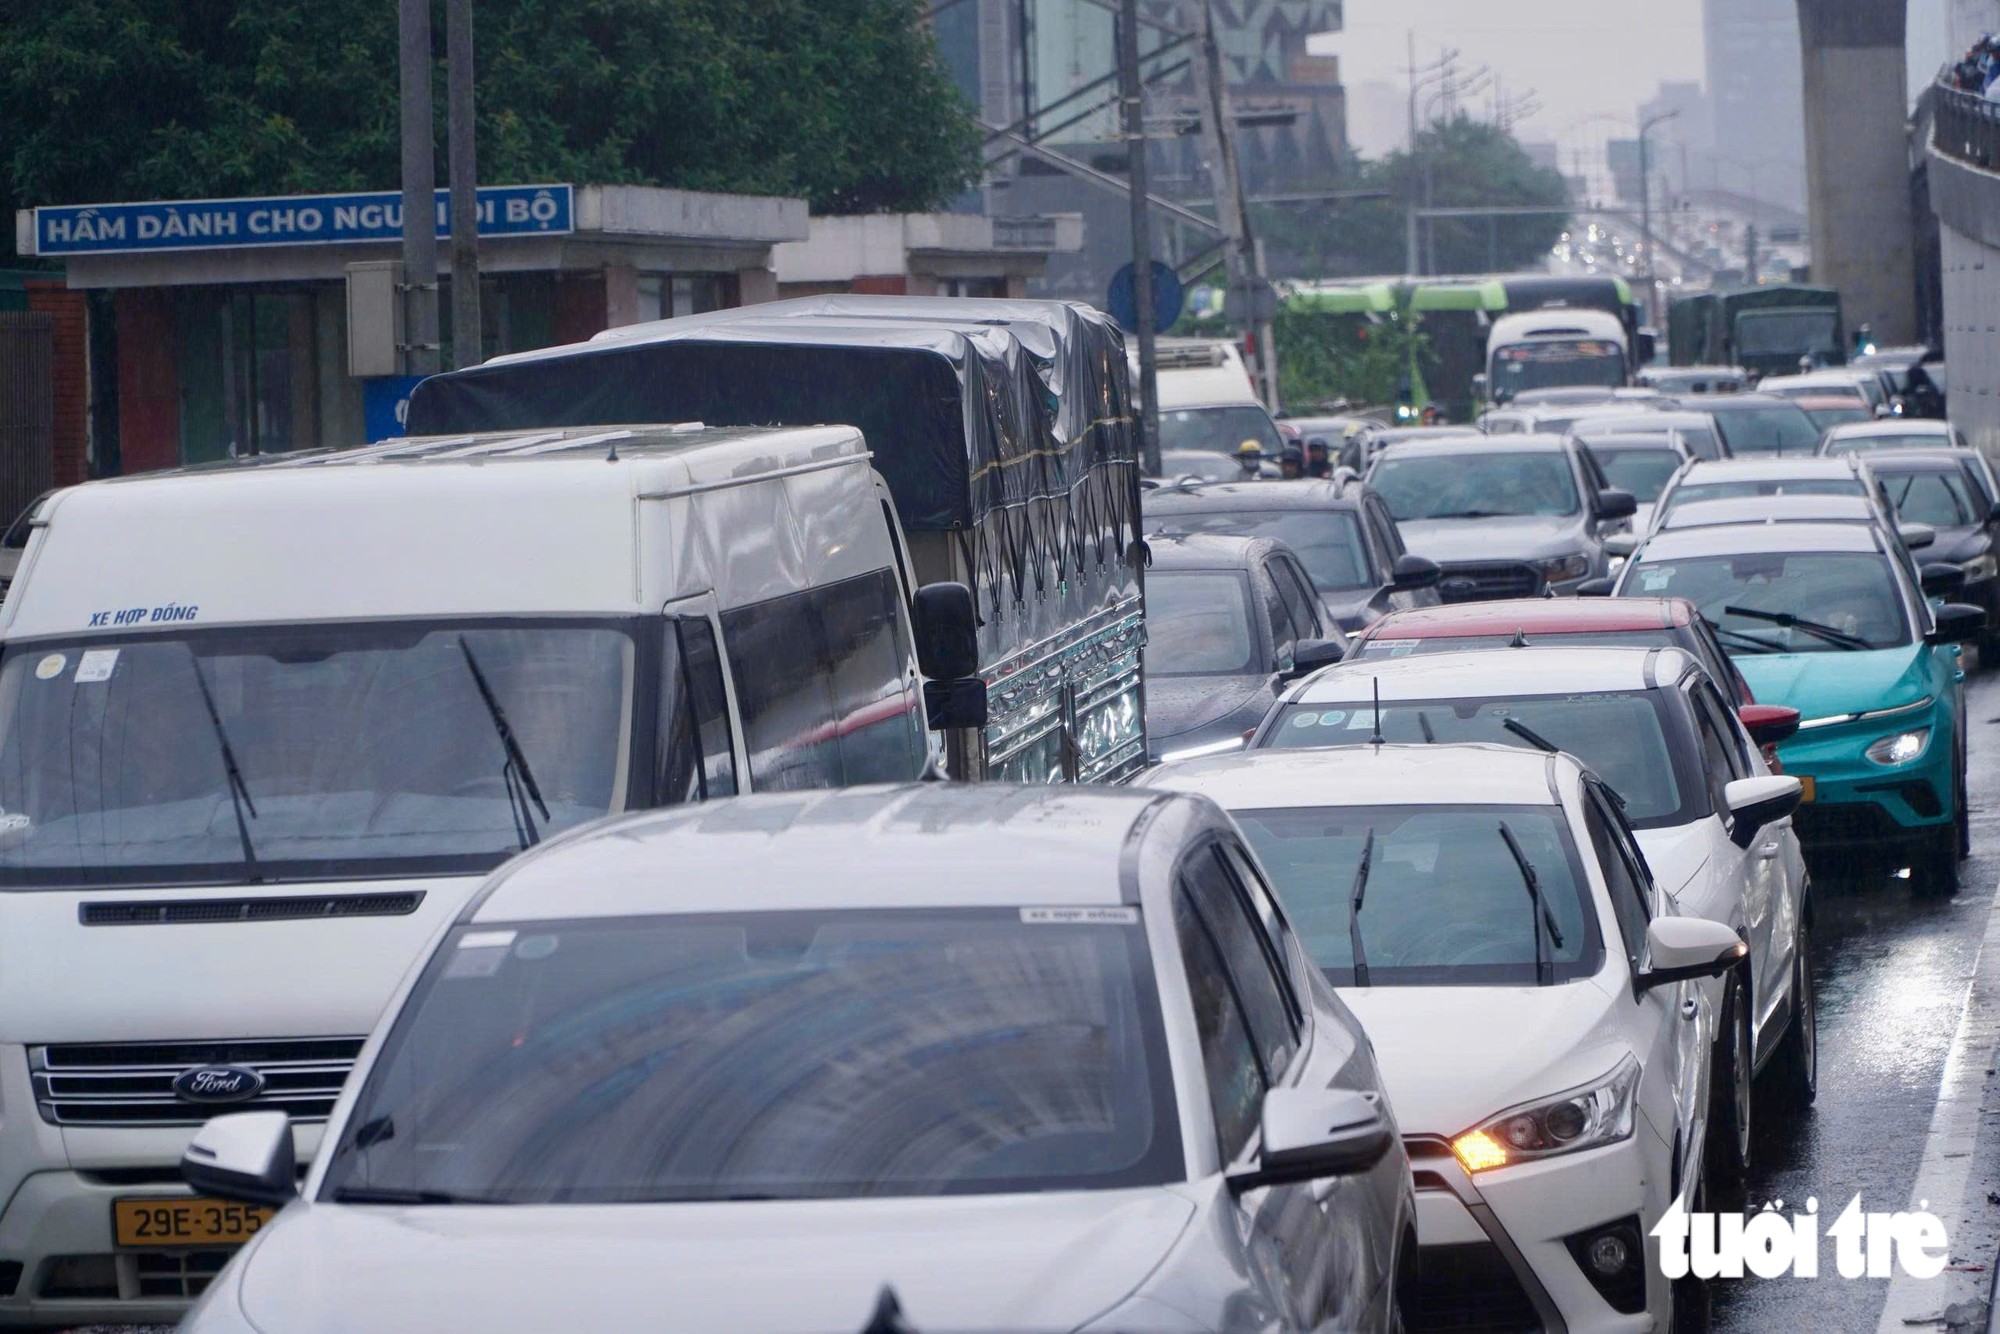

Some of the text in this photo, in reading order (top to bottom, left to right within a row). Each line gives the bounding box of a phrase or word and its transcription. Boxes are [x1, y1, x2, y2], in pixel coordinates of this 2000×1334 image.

[47, 207, 126, 243] HẦM
[136, 207, 238, 240] DÀNH
[248, 206, 323, 234] CHO
[506, 189, 558, 230] BỘ
[88, 611, 111, 627] XE
[113, 608, 148, 626] HỢP
[190, 1070, 242, 1093] Ford
